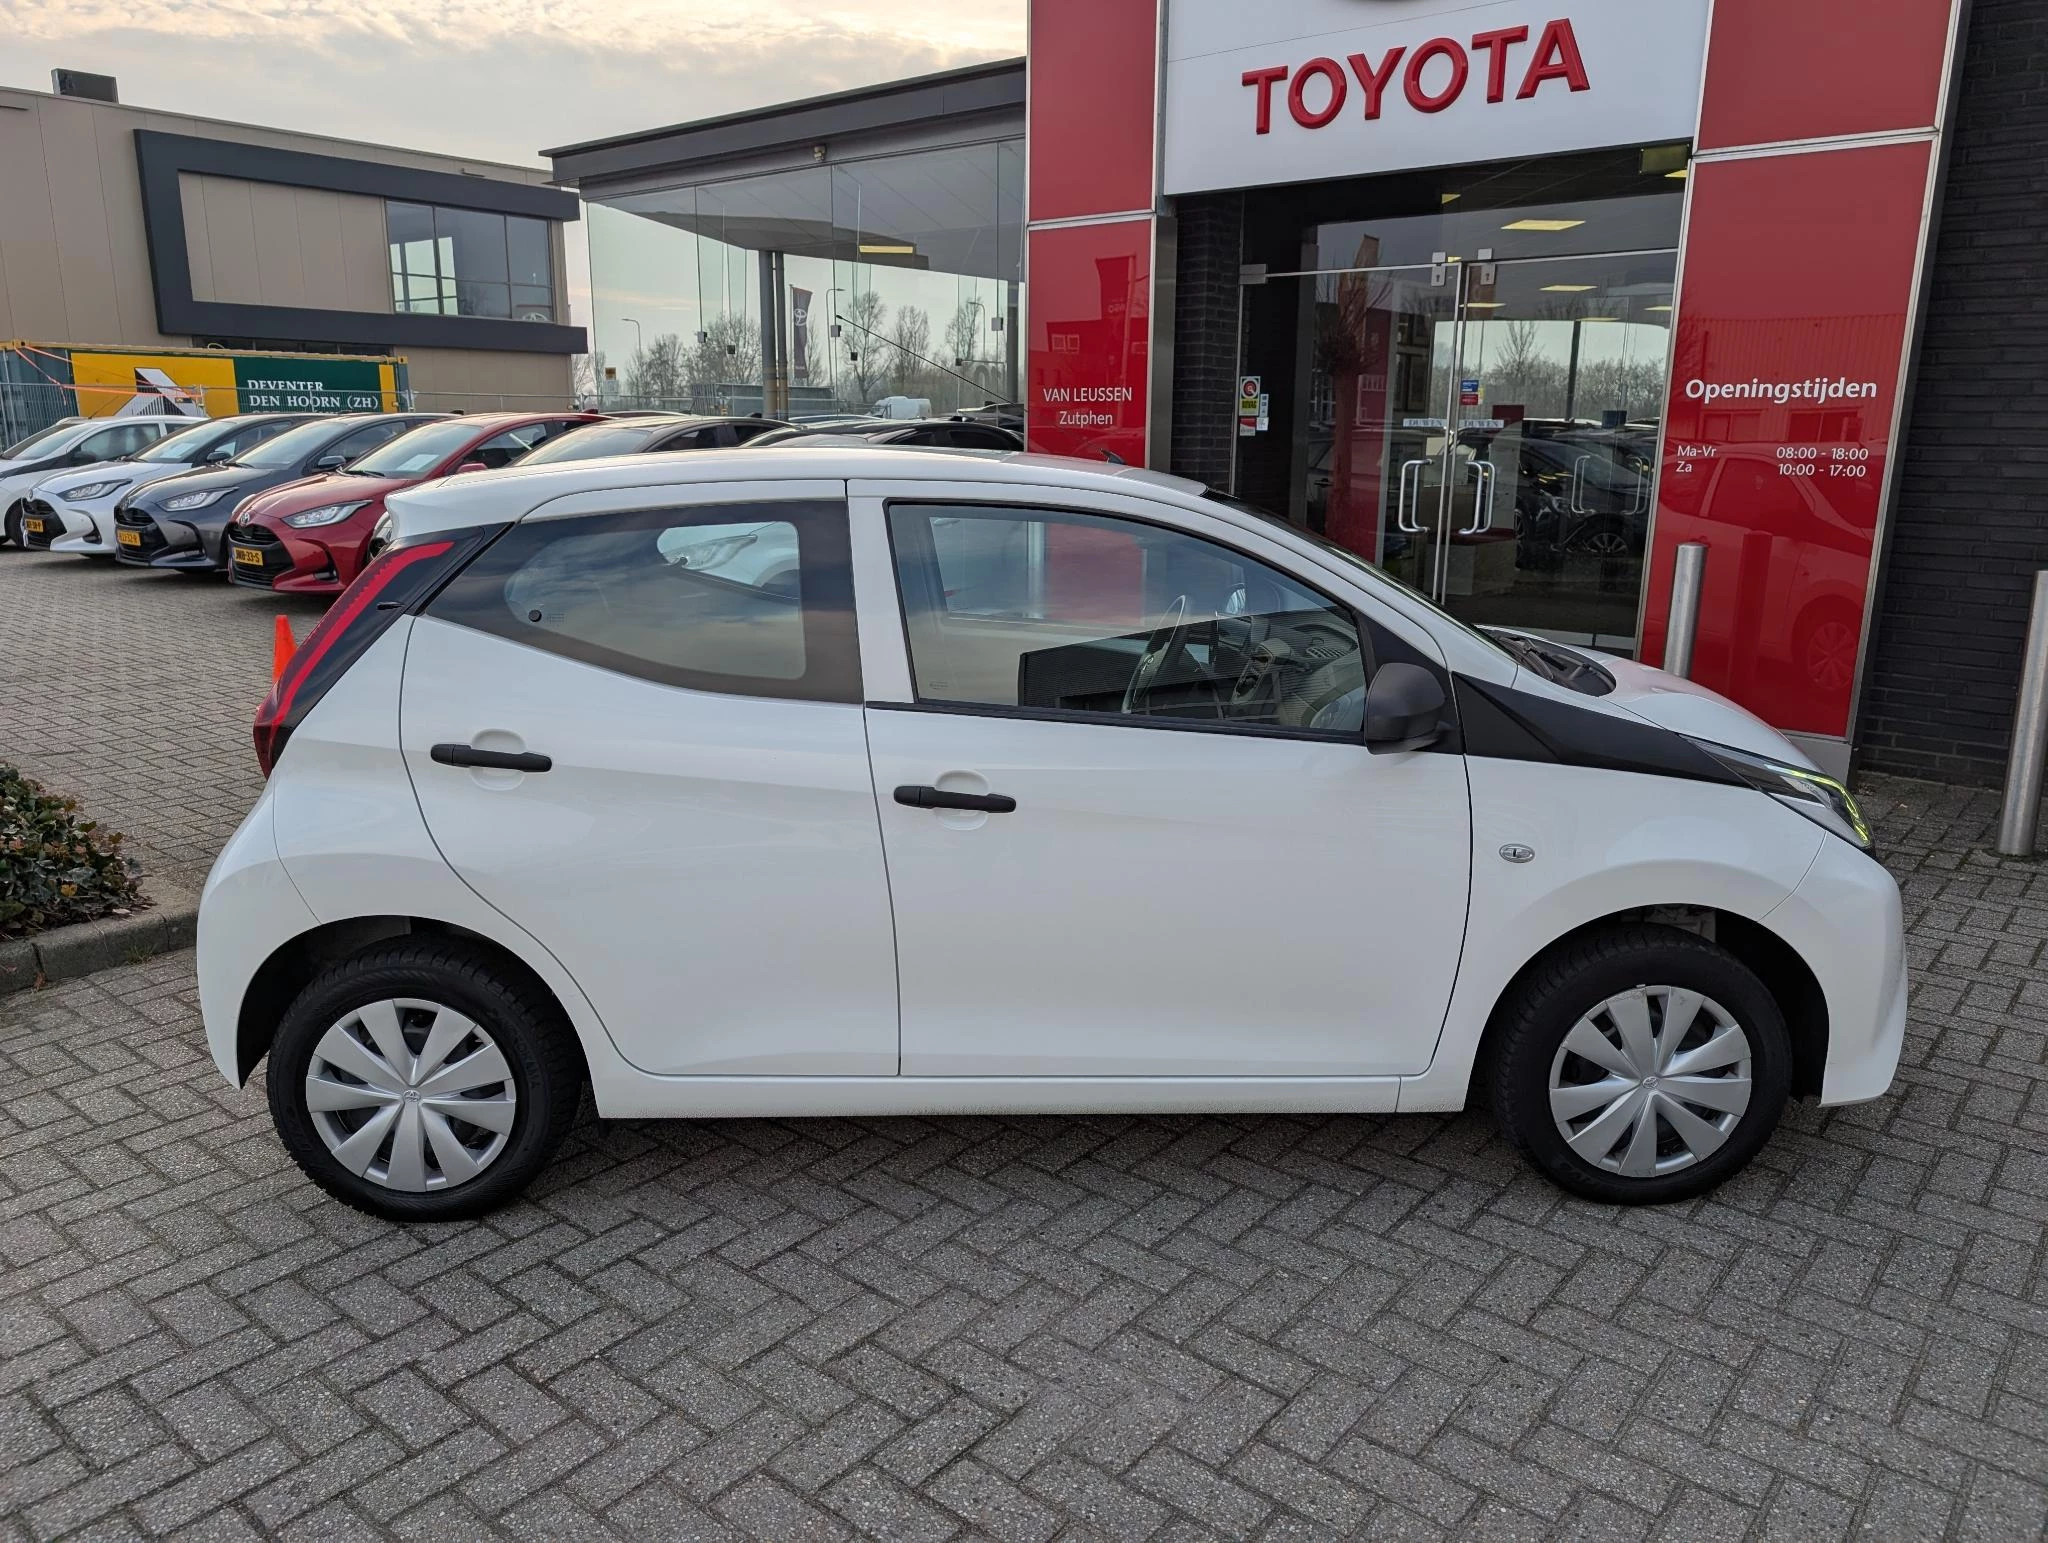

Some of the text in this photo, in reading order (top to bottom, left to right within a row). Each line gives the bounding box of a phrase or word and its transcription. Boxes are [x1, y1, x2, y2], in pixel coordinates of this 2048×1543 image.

[1241, 17, 1591, 135] TOYOTA
[247, 380, 324, 391] DEVENTER
[1685, 377, 1877, 404] Openingstijden
[249, 395, 379, 410] DEN HOORN (ZH)
[1043, 387, 1132, 402] VAN LEUSSEN
[1059, 410, 1113, 429] Zutphen
[1677, 445, 1717, 457] Ma-Vr
[1776, 447, 1817, 460] 08:00
[1831, 448, 1869, 461] 18:00
[1676, 461, 1692, 473] Za
[1779, 464, 1815, 476] 10:00
[1830, 464, 1866, 477] 17:00
